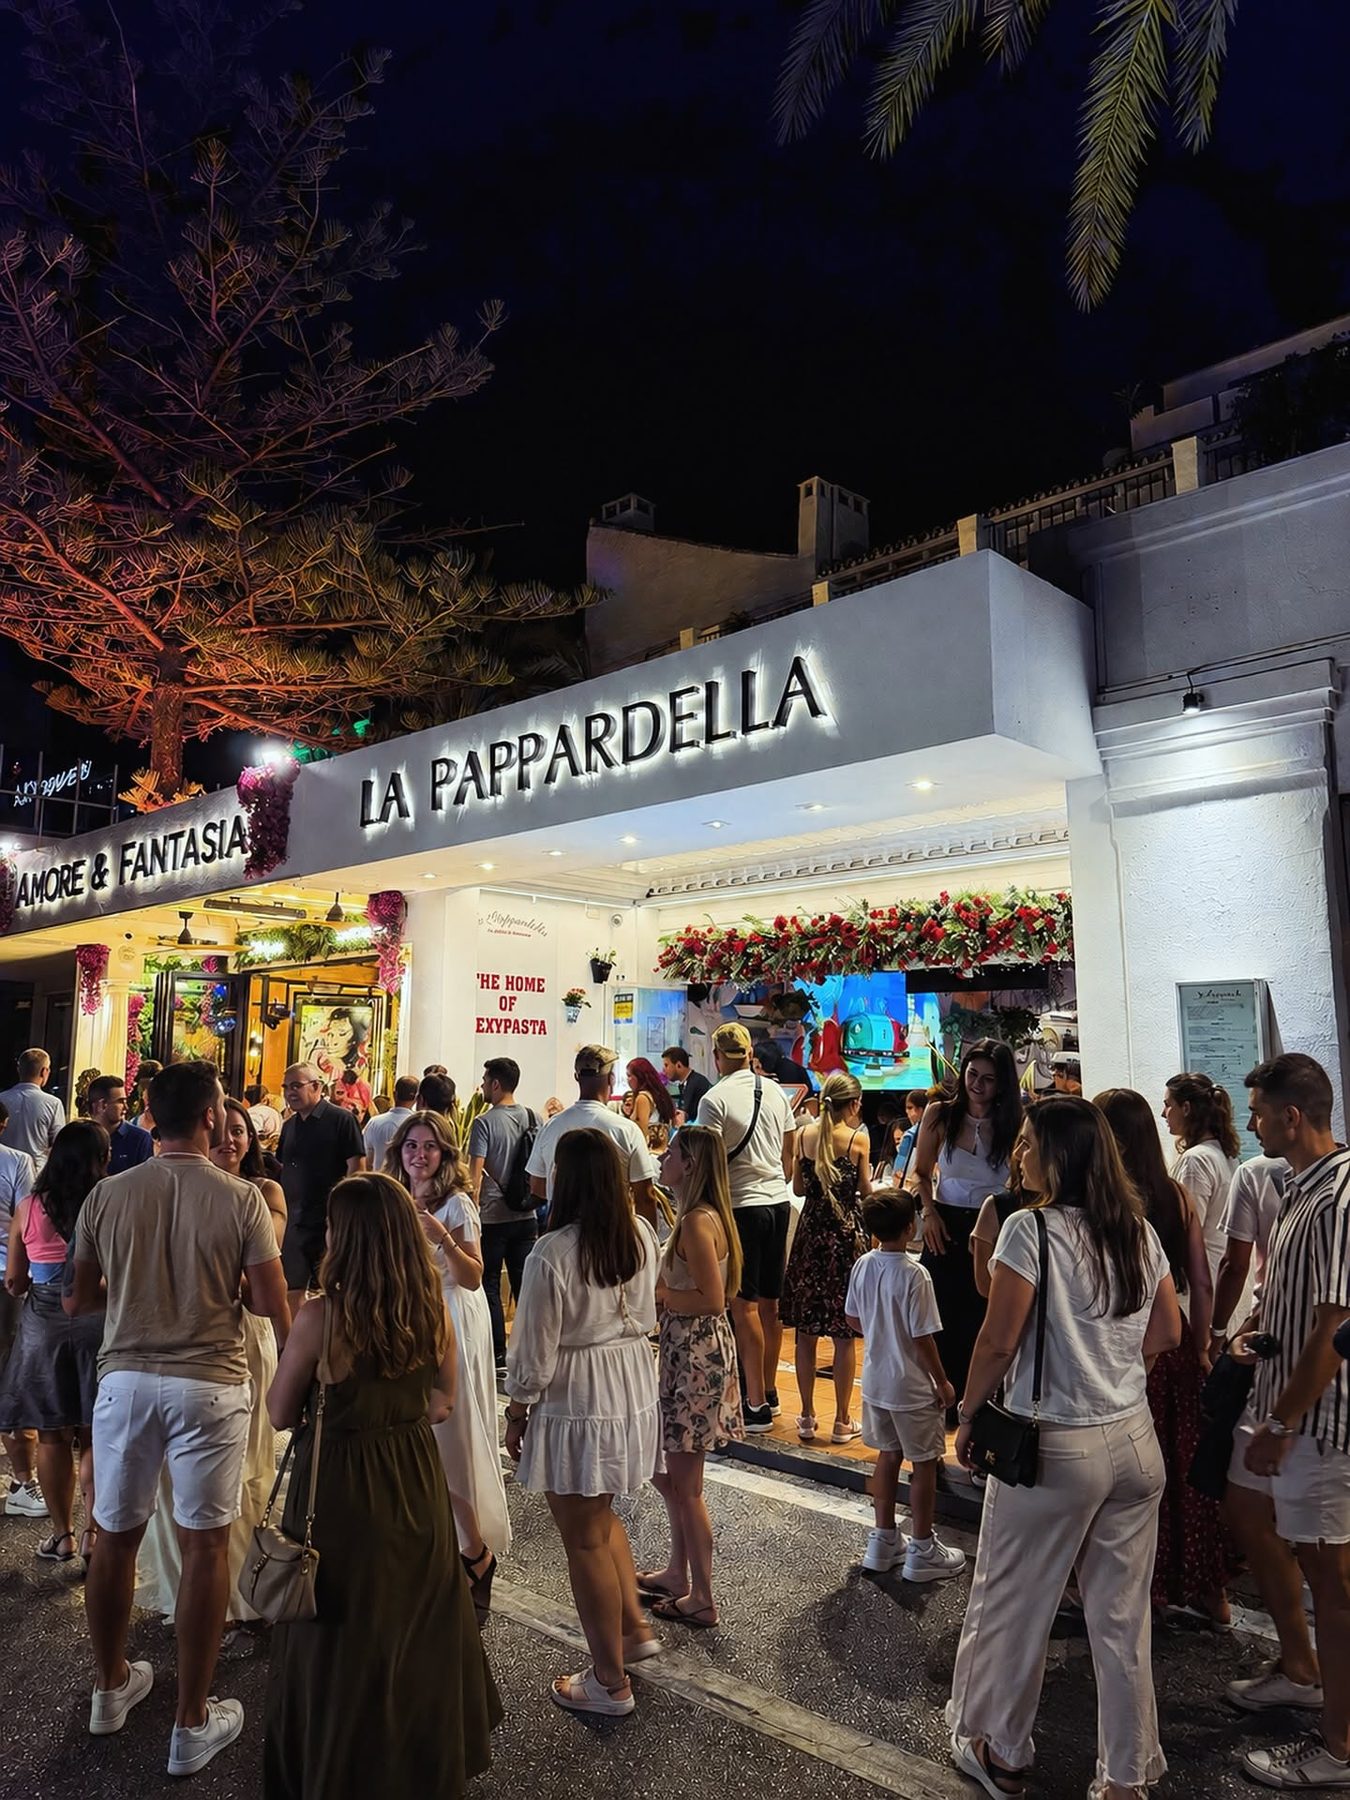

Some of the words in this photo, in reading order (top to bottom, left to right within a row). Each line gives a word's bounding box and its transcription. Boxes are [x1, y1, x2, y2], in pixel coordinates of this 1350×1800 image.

[360, 772, 411, 828] LA
[431, 656, 827, 812] PAPPARDELLA
[15, 859, 87, 909] AMORE
[91, 853, 110, 891] &
[119, 815, 249, 886] FANTASIA
[505, 975, 545, 993] HOME
[499, 996, 517, 1012] OF
[475, 1017, 547, 1035] EXYPASTA
